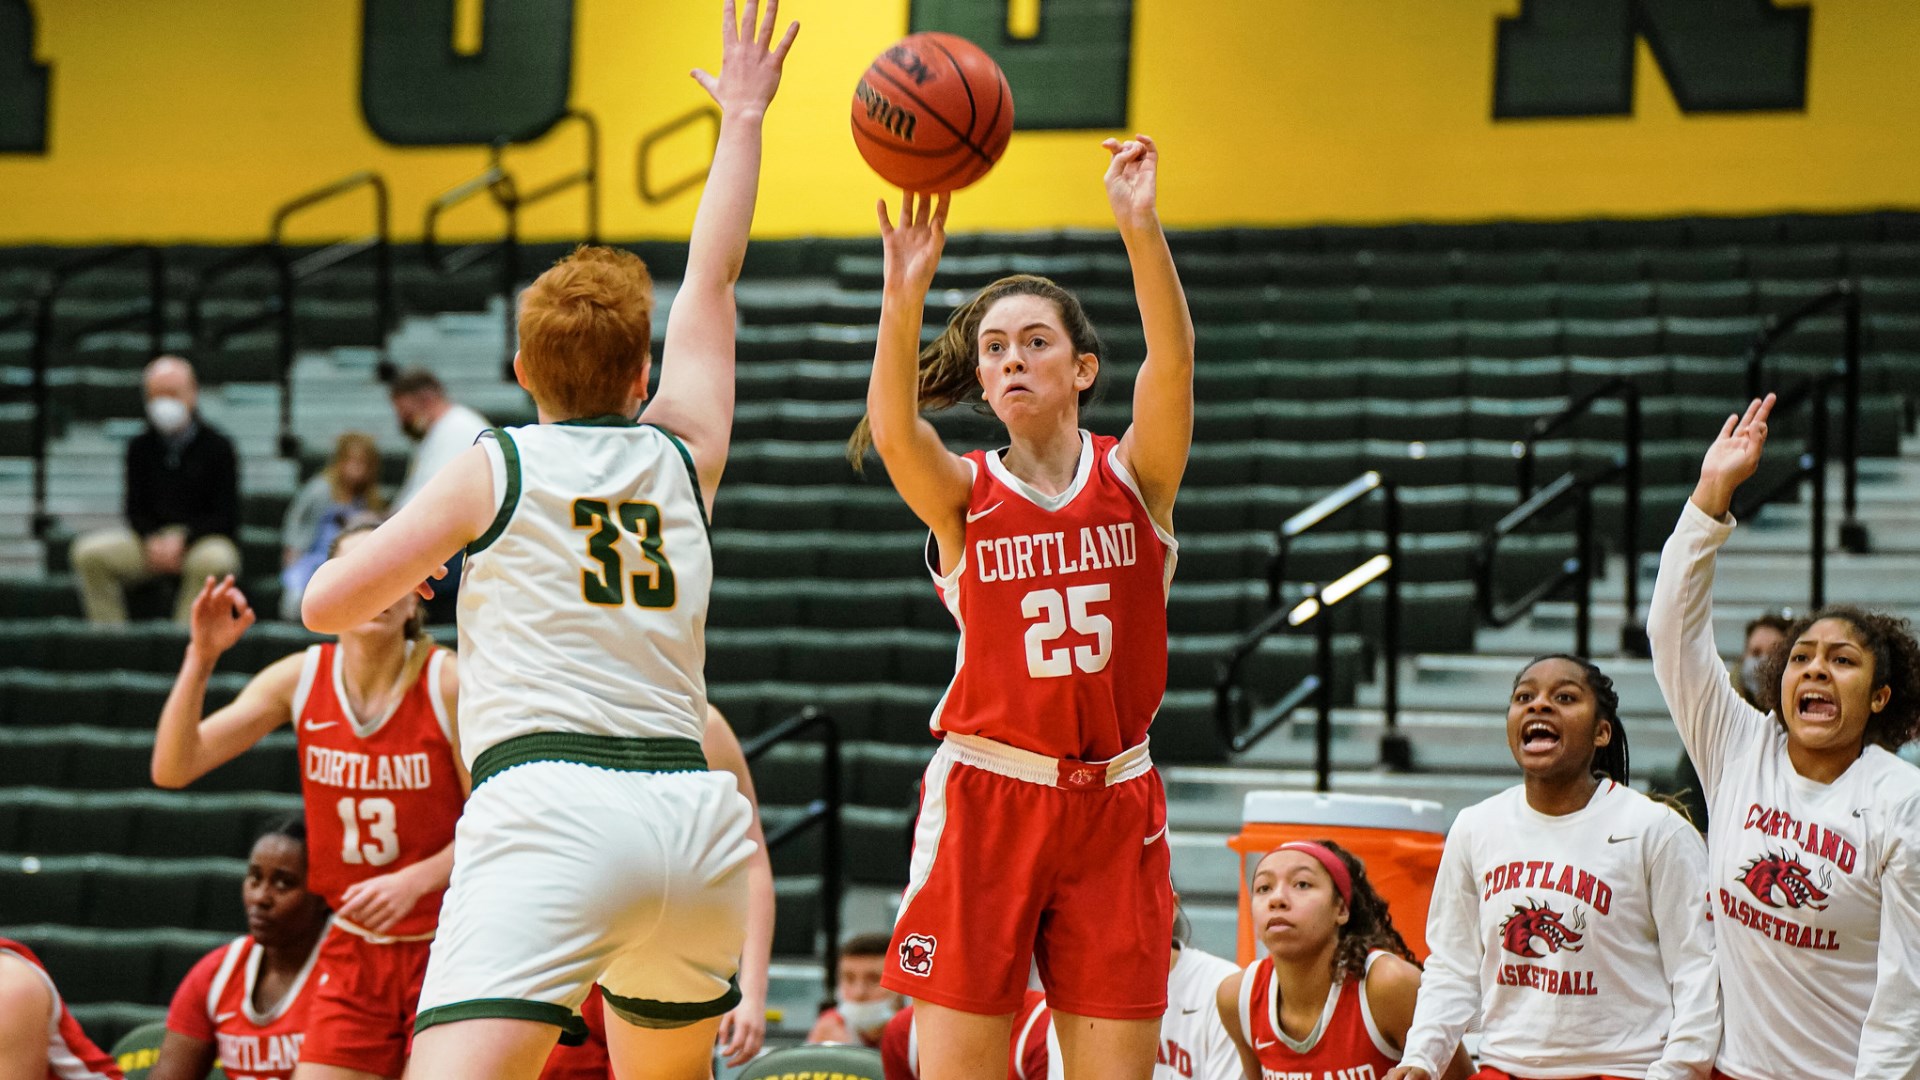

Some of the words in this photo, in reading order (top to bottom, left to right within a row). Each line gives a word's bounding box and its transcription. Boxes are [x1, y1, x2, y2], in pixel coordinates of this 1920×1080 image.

[570, 497, 677, 611] 33
[976, 522, 1137, 583] CORTLAND
[1021, 583, 1113, 678] 25
[306, 745, 431, 790] CORTLAND
[337, 797, 399, 866] 13
[1484, 861, 1613, 916] CORTLAND
[1497, 964, 1598, 995] ASKETBALL
